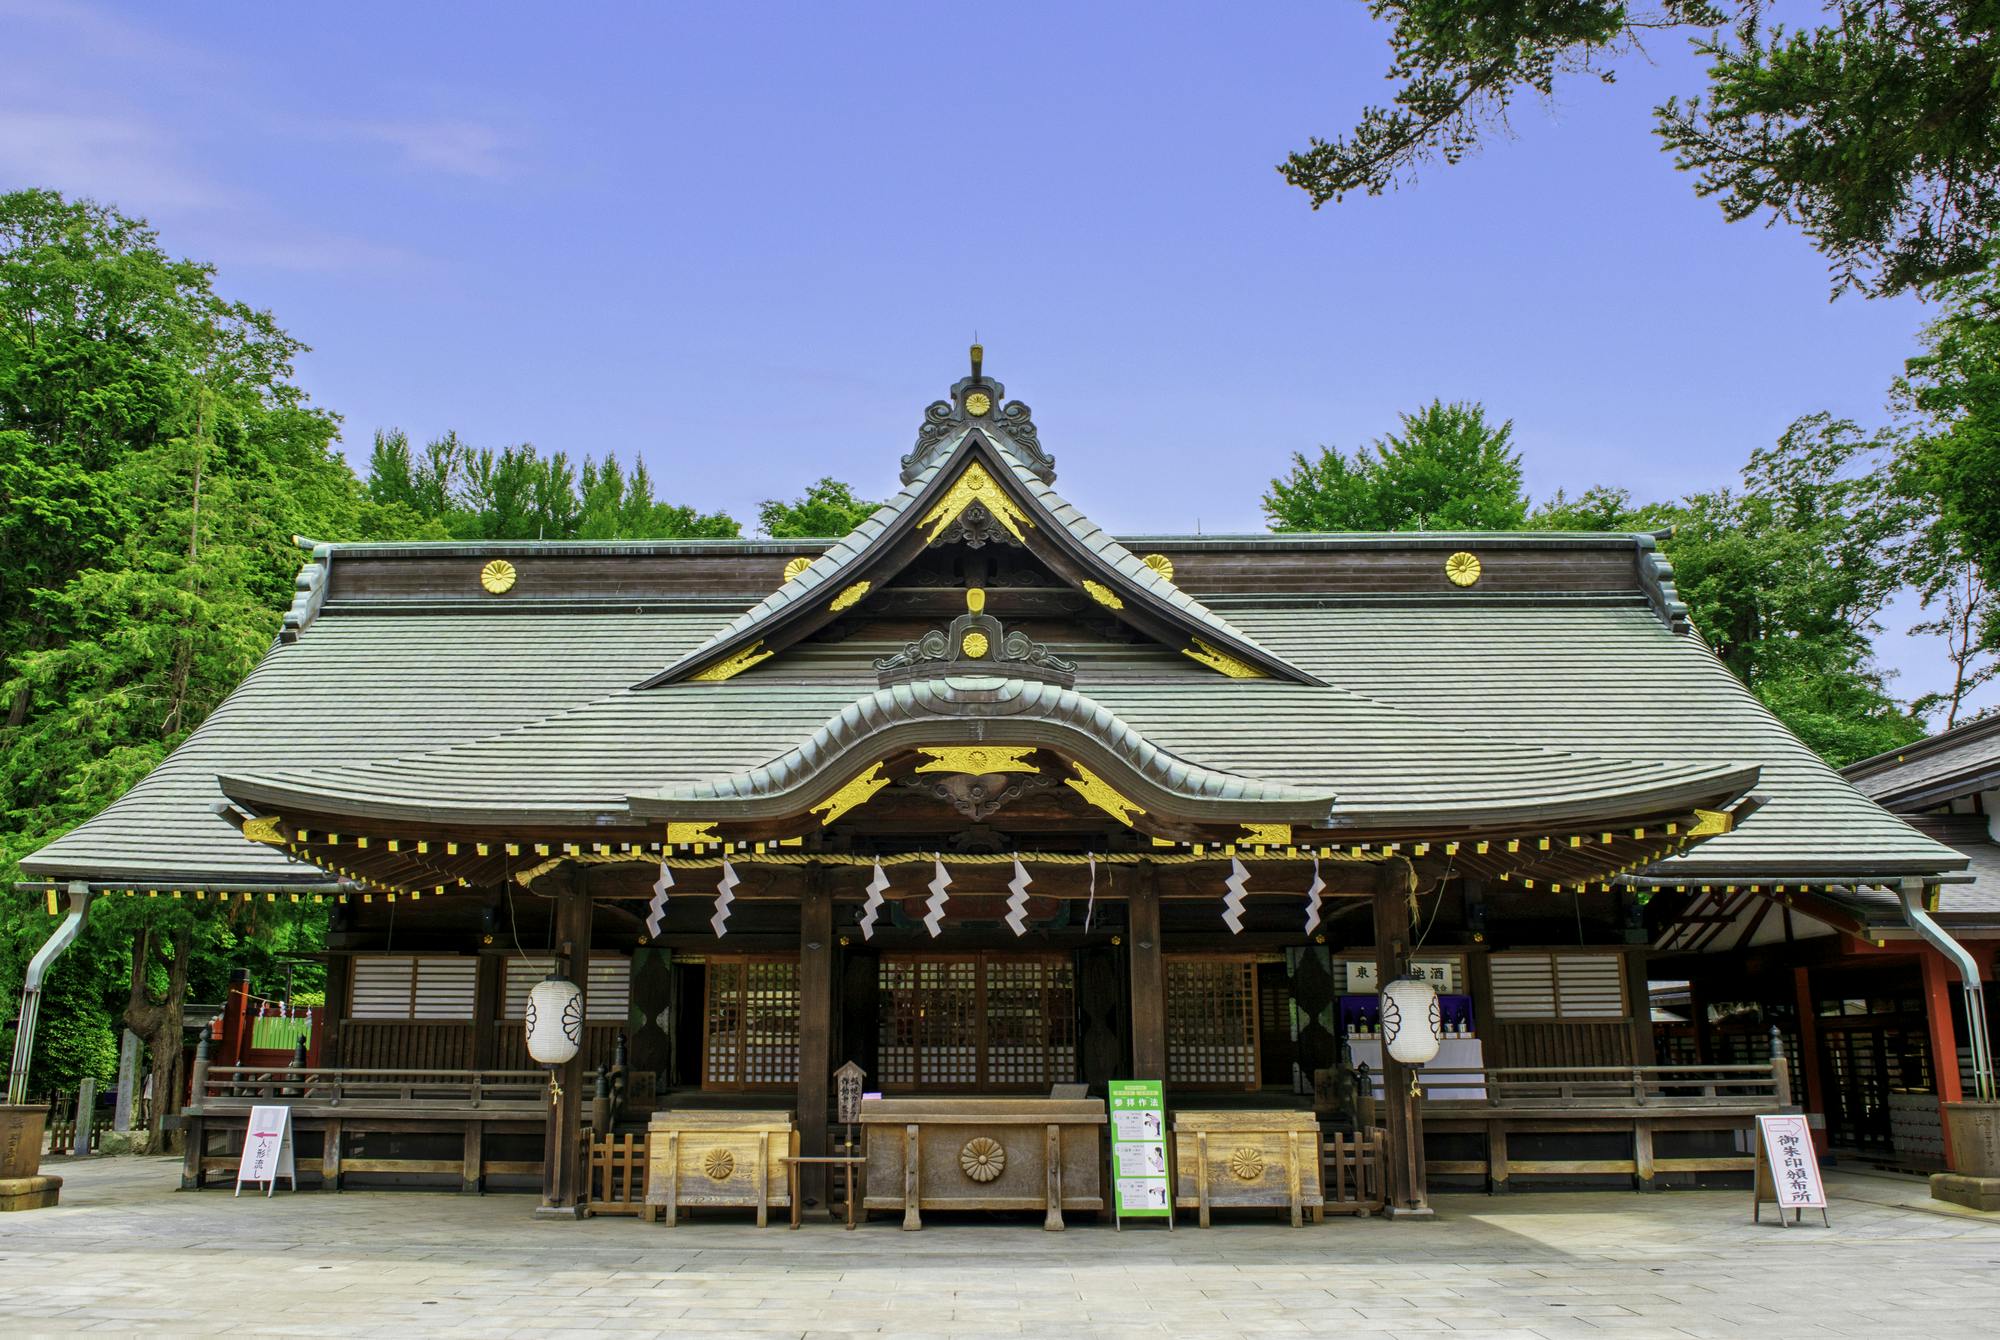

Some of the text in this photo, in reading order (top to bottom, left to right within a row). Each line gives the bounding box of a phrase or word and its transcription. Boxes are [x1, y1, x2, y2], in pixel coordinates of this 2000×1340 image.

[1356, 966, 1444, 980] 東地酒
[254, 1139, 267, 1179] 人形流し
[1777, 1135, 1812, 1203] 御朱印頒布所
